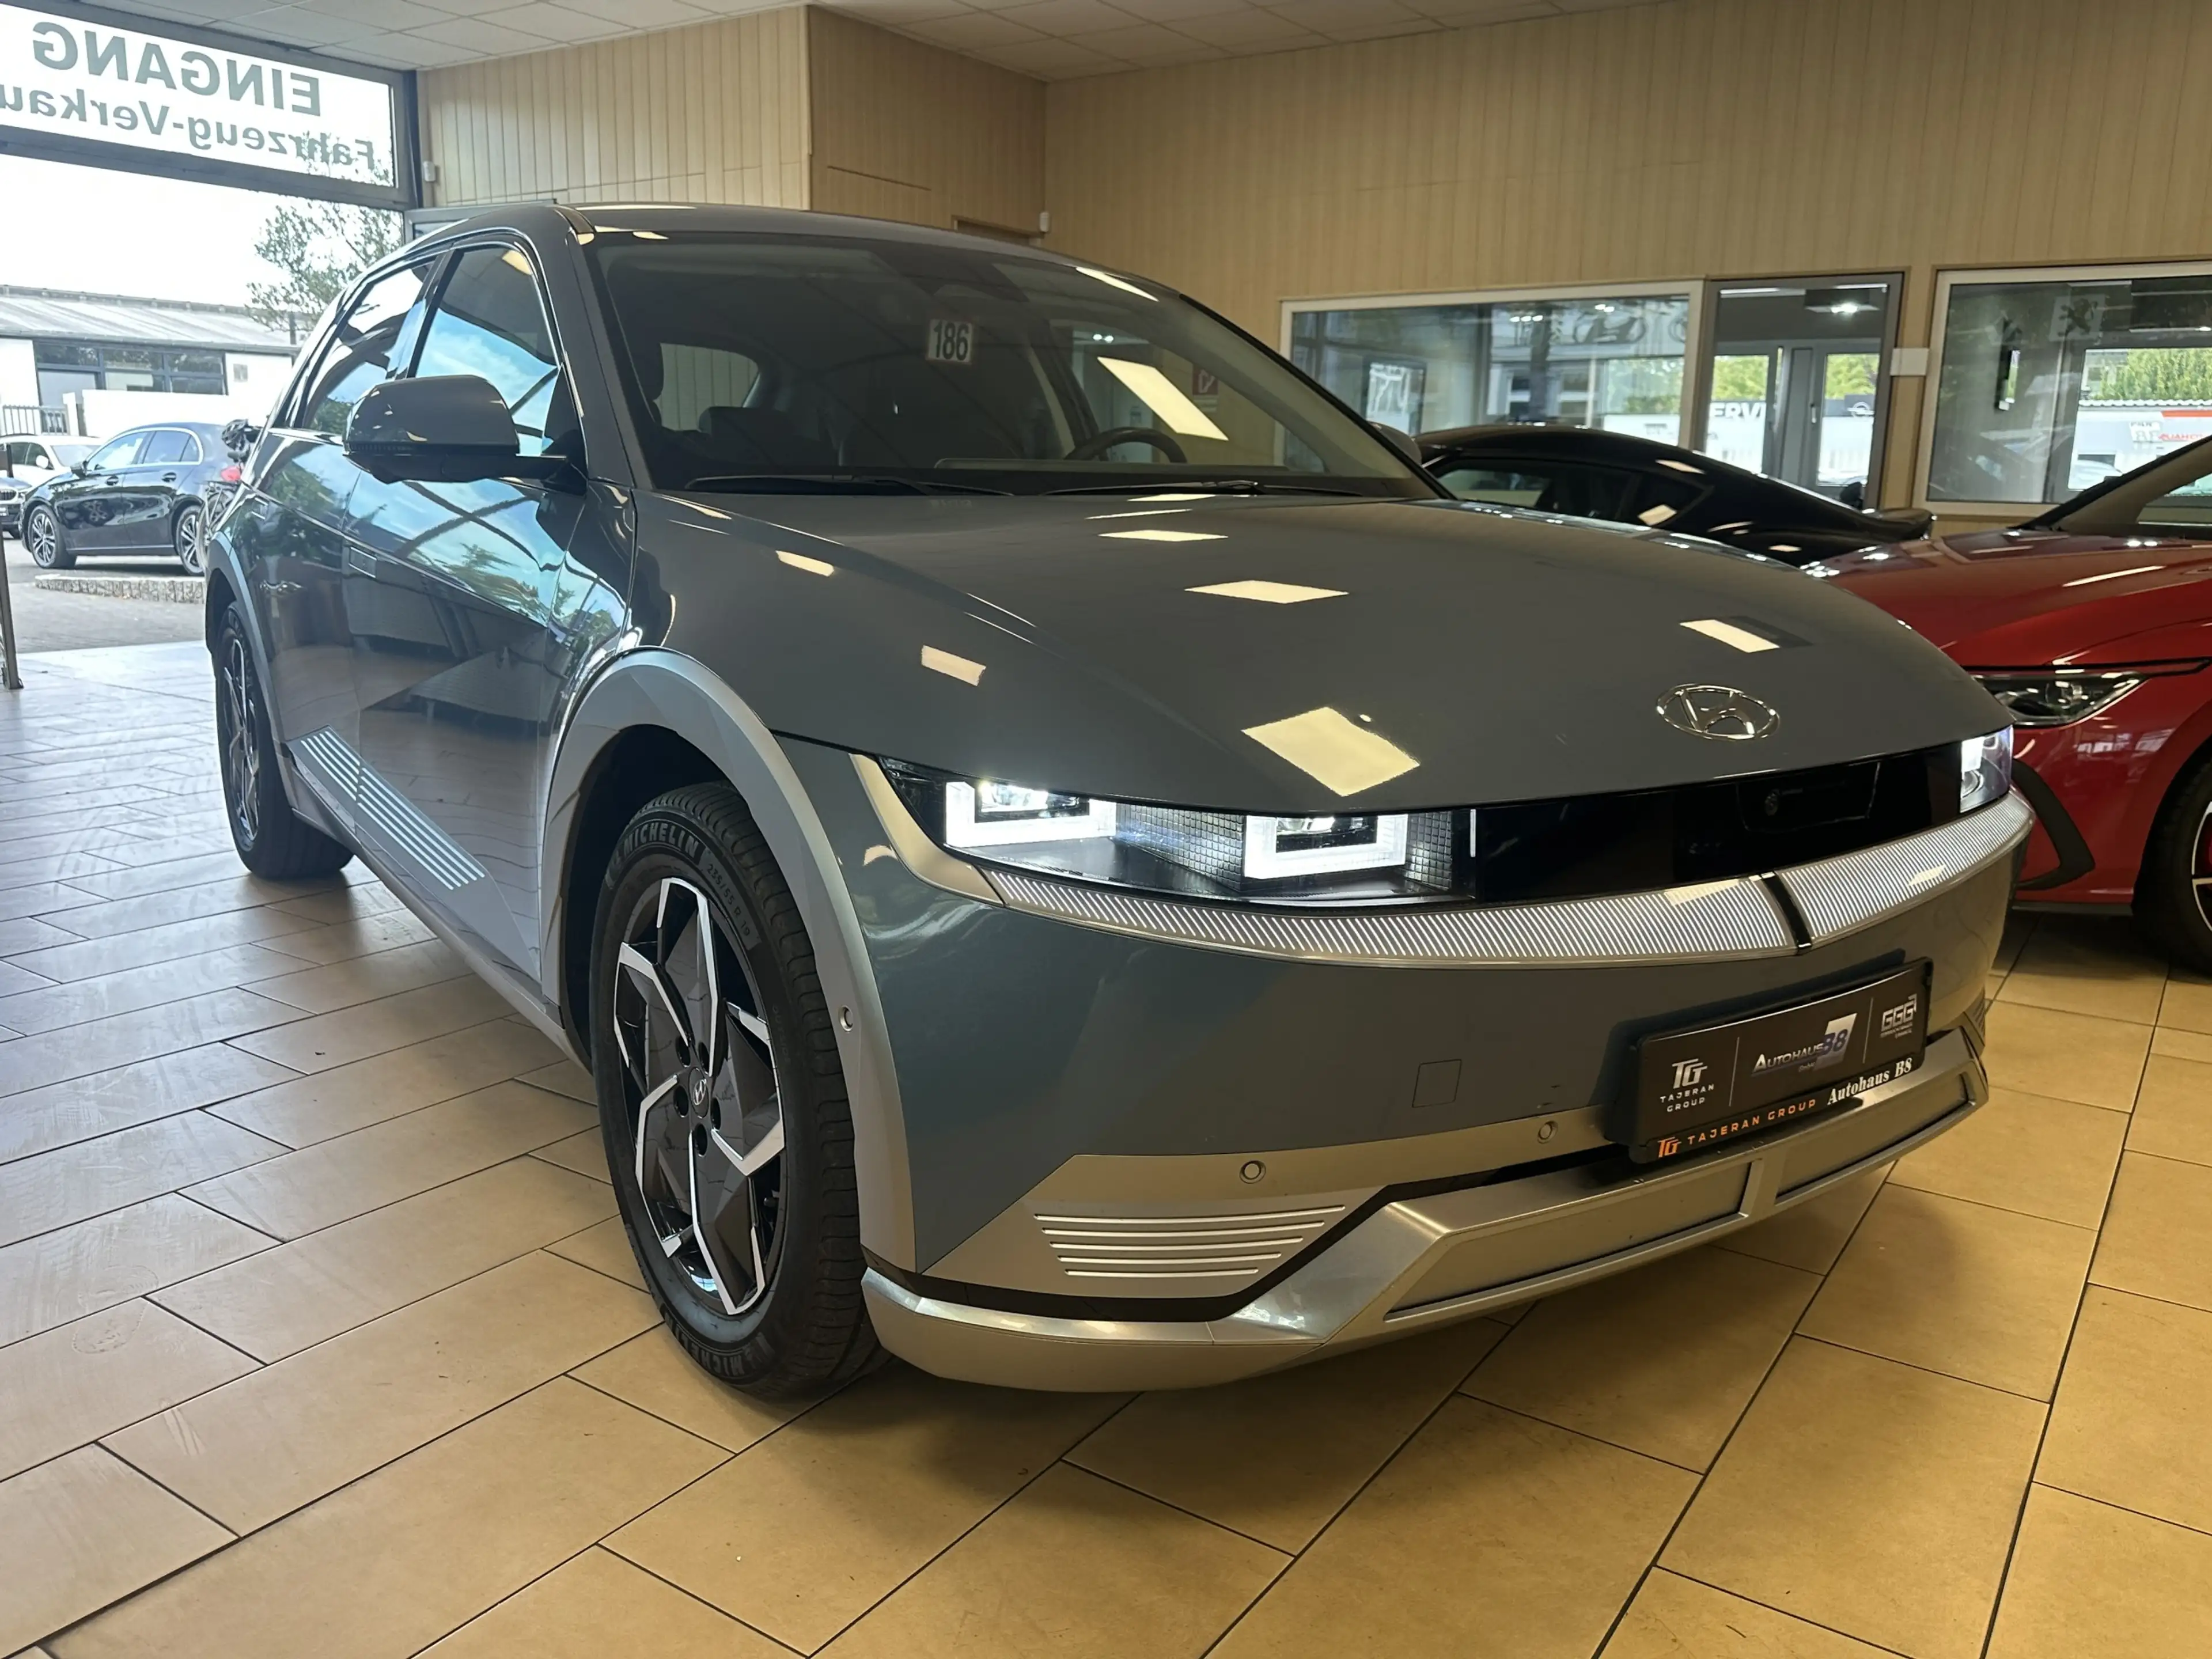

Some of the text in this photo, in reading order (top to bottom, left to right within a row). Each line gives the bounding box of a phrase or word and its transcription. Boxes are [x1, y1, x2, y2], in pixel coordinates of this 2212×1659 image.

[933, 320, 969, 361] 186
[623, 822, 699, 858] MICHELIN
[1660, 1084, 1715, 1103] TAJERAN
[1666, 1097, 1706, 1112] GROUP
[1687, 1116, 1760, 1145] TAJERAN
[1767, 1099, 1816, 1120] GROUP
[1827, 1070, 1890, 1105] Autohaus
[1894, 1058, 1912, 1078] B8
